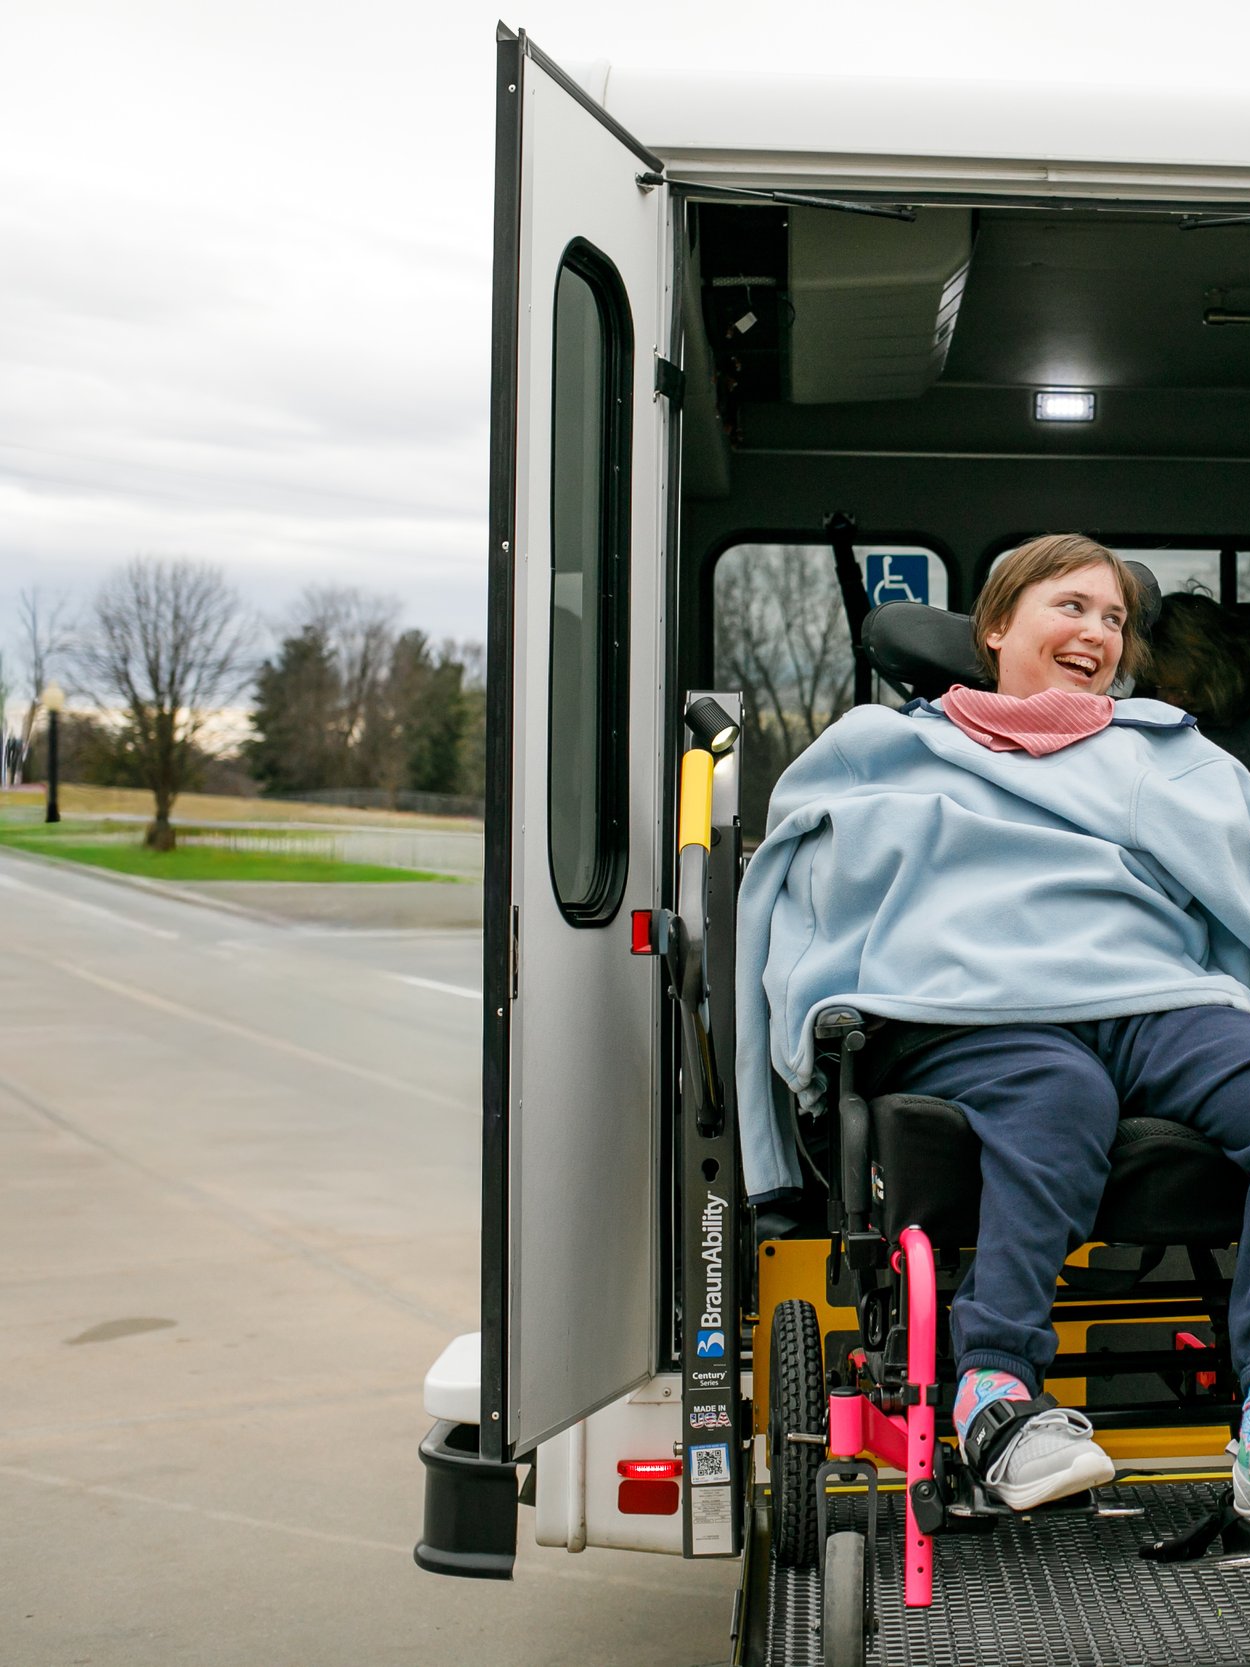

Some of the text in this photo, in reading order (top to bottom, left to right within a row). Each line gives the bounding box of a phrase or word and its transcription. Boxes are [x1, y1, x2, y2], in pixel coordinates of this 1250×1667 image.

[701, 1194, 729, 1328] BraunAbility
[692, 1371, 726, 1381] Century
[693, 1404, 727, 1413] MADE IN
[689, 1411, 732, 1429] USA
